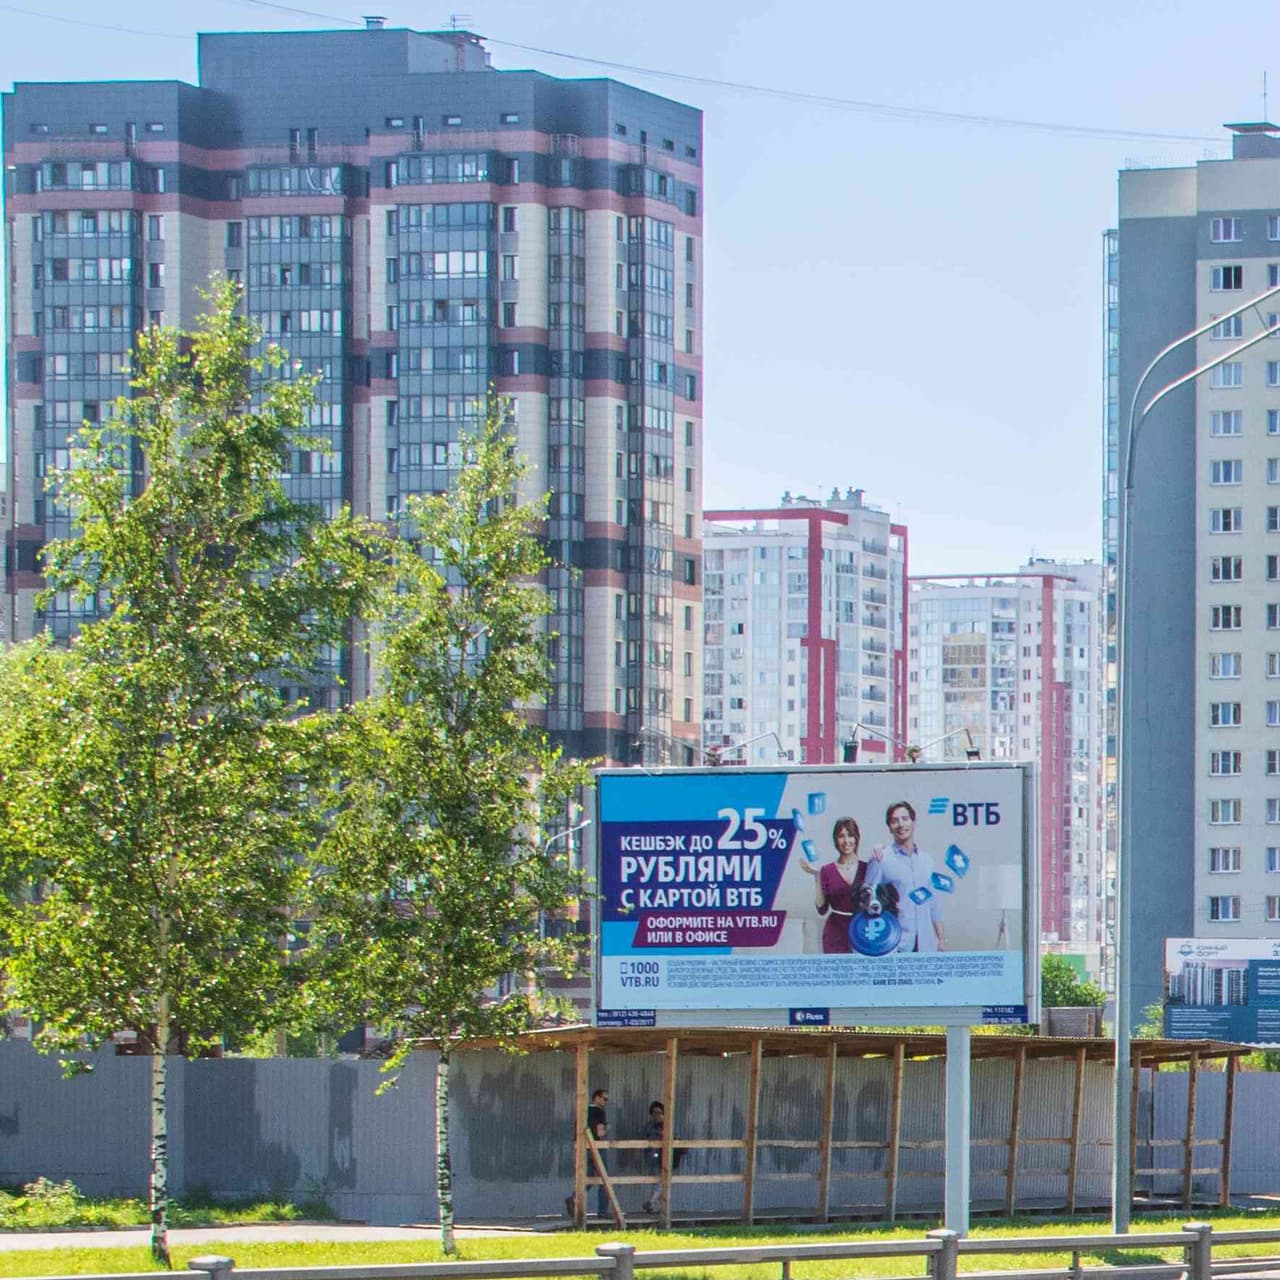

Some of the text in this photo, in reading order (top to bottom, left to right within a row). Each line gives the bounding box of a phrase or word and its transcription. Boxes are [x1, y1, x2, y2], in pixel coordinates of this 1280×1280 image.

[952, 802, 1001, 826] ВТБ
[620, 807, 787, 853] КЕШБЭК ДО 25%
[620, 854, 762, 883] РУБЛЯМИ
[620, 884, 763, 908] С КАРТОЙ ВТБ
[647, 915, 778, 929] ОФОРМИТЕ НА VTB.RU
[647, 930, 728, 943] ИЛИ В ОФИСЕ
[630, 961, 660, 975] 1000
[620, 976, 660, 988] VTB.RU
